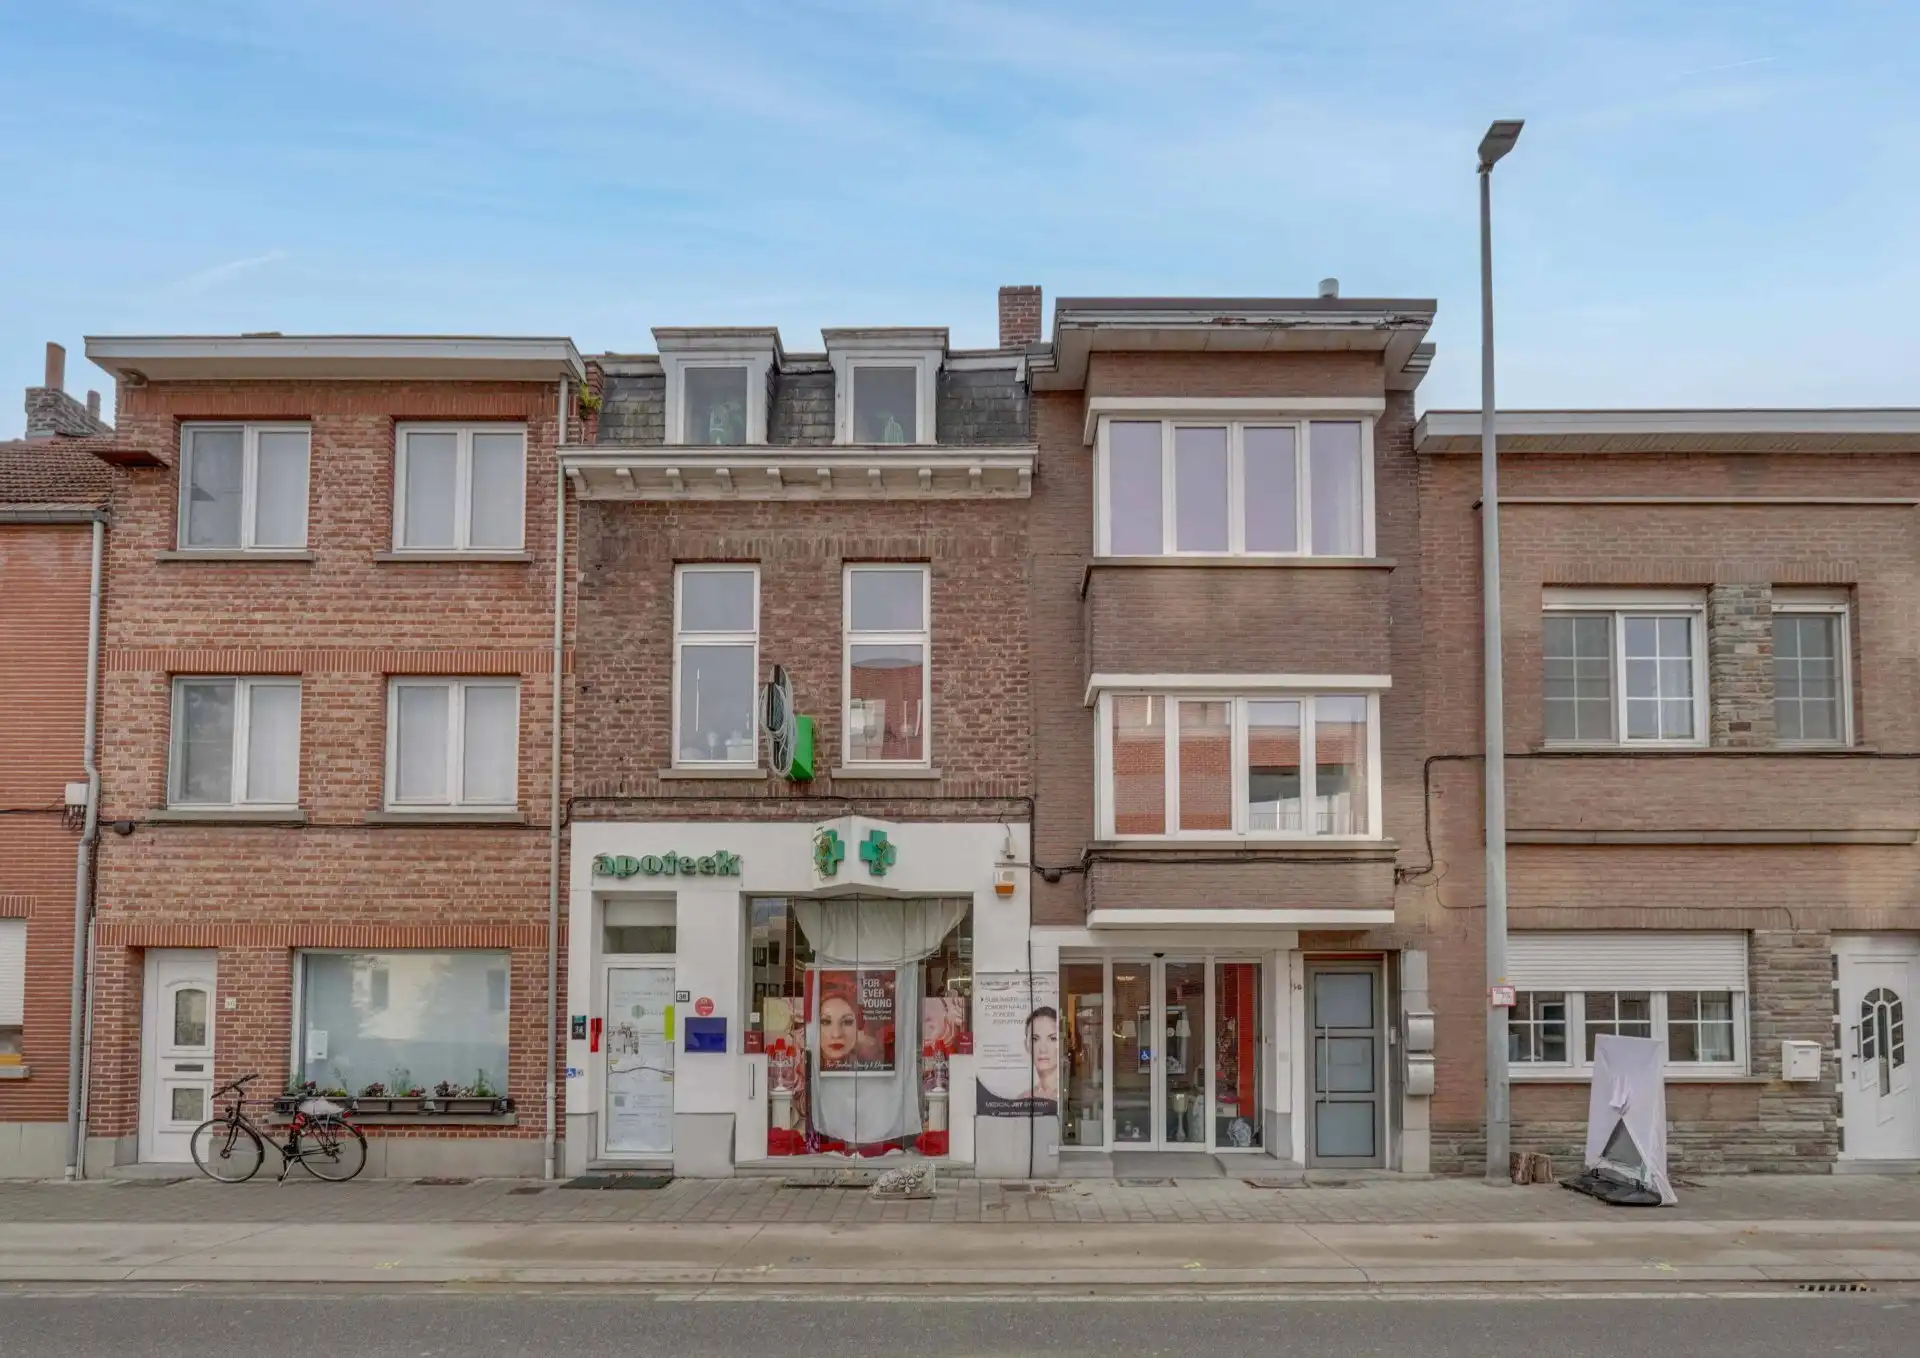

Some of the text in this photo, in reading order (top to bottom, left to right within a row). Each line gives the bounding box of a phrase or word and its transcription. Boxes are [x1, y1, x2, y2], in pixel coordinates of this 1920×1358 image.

[592, 850, 741, 878] apoteek
[863, 979, 880, 988] FOR
[862, 988, 885, 998] EVER
[863, 998, 892, 1008] YOUNG
